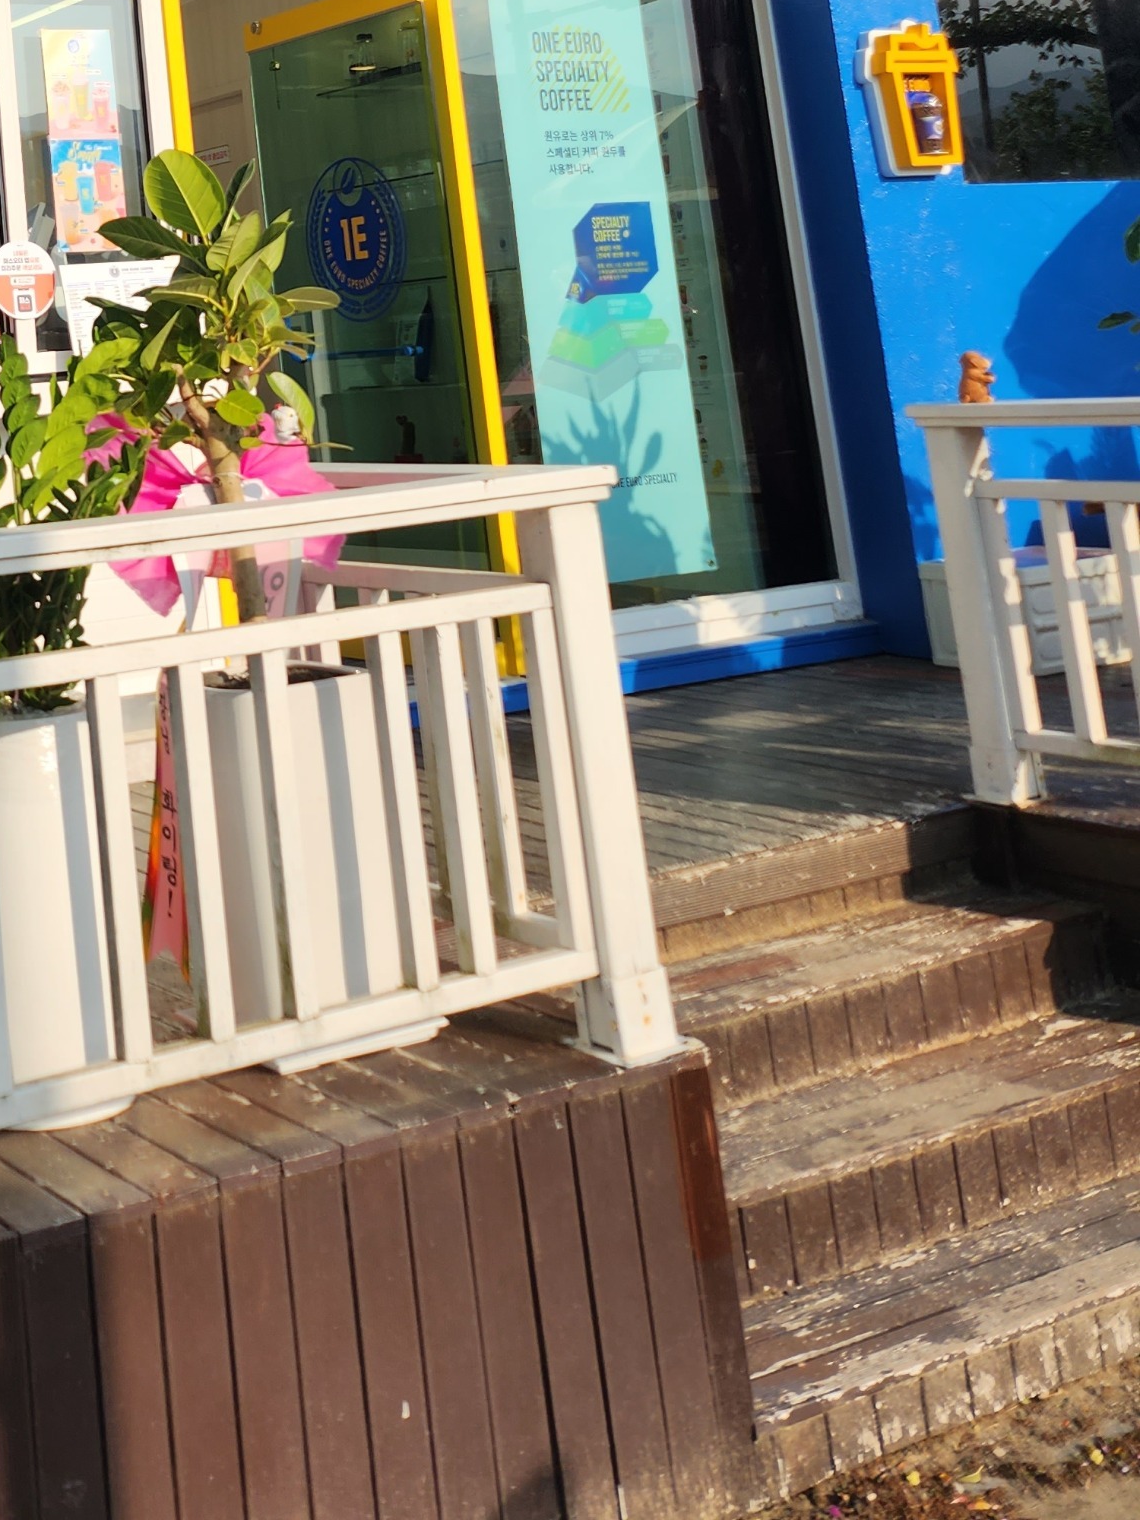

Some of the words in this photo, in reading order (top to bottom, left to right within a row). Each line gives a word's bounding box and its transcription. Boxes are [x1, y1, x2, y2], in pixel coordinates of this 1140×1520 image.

[532, 31, 562, 54] ONE
[564, 32, 602, 55] EURO
[536, 60, 609, 83] SPECIALTY
[540, 89, 593, 112] COFFEE
[544, 130, 578, 142] 원유로는
[580, 130, 597, 142] 상위
[599, 130, 614, 141] 7%
[546, 146, 580, 158] 스페셜티
[581, 146, 599, 157] 커피
[601, 145, 626, 158] 원두를
[549, 163, 594, 175] 사용합니다.
[591, 216, 629, 229] SPECIALTY
[340, 216, 369, 260] 1E
[593, 229, 620, 242] COFFEE
[376, 230, 387, 268] COFFEE
[625, 476, 643, 488] EURO
[644, 472, 678, 486] SPECIALTY
